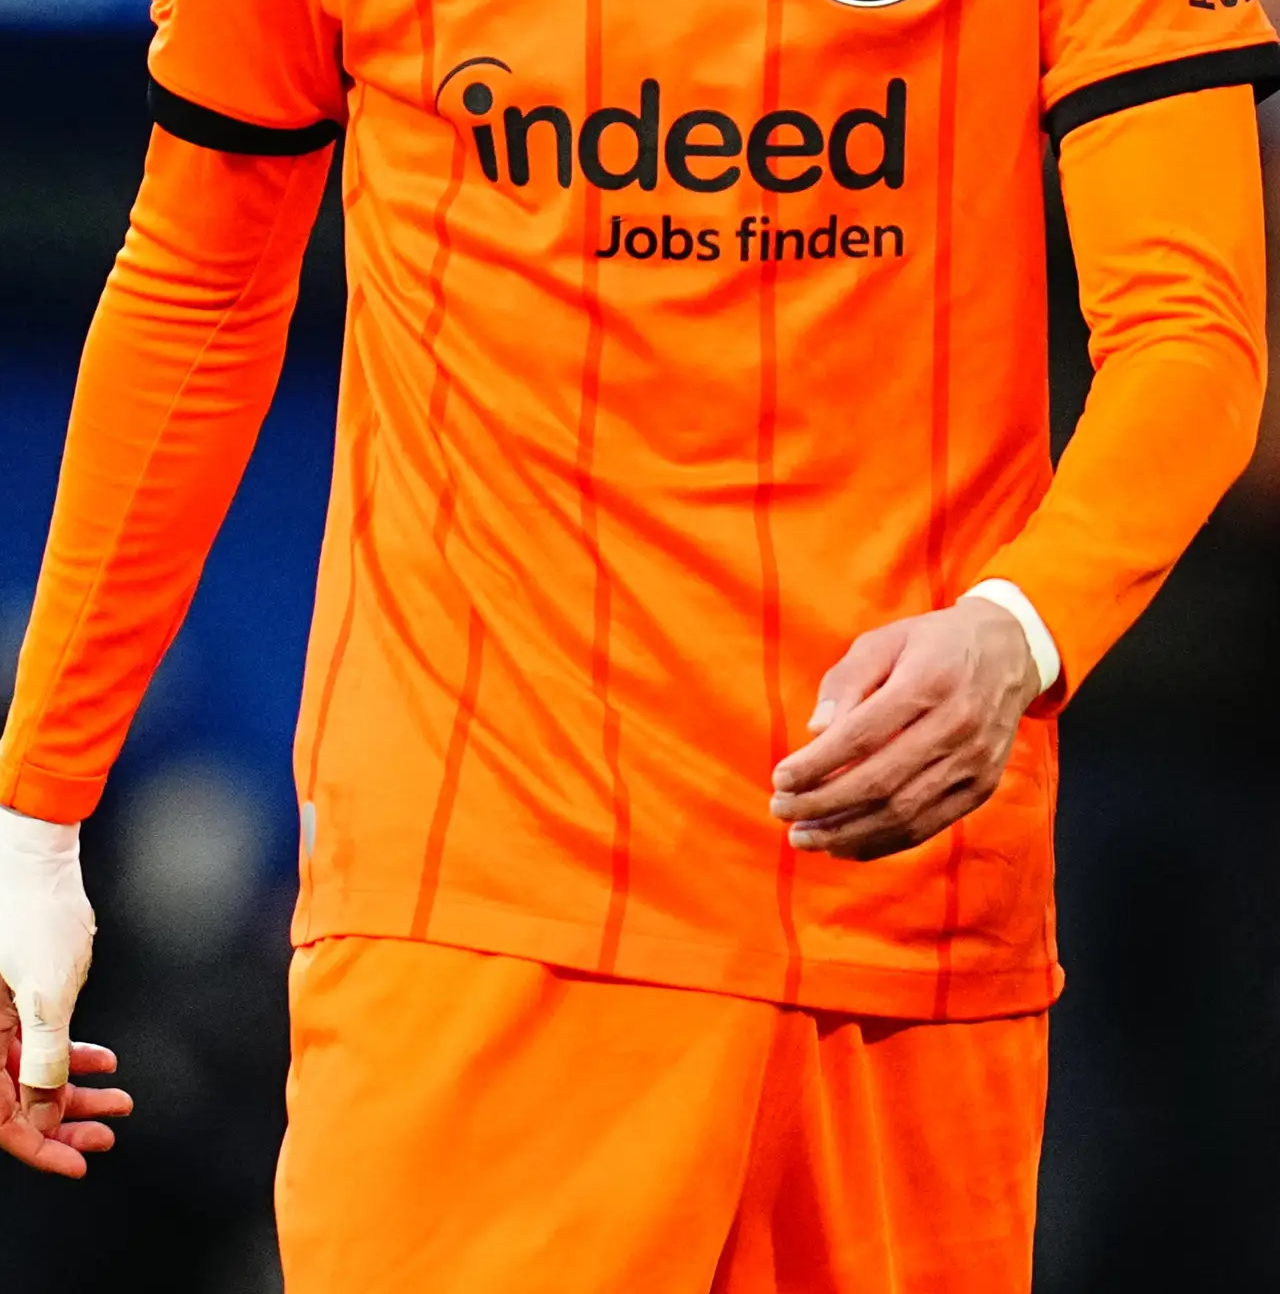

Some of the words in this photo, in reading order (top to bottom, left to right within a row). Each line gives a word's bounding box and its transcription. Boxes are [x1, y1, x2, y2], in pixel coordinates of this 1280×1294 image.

[460, 77, 907, 194] indeed
[595, 215, 721, 262] Jobs
[735, 214, 905, 263] finden
